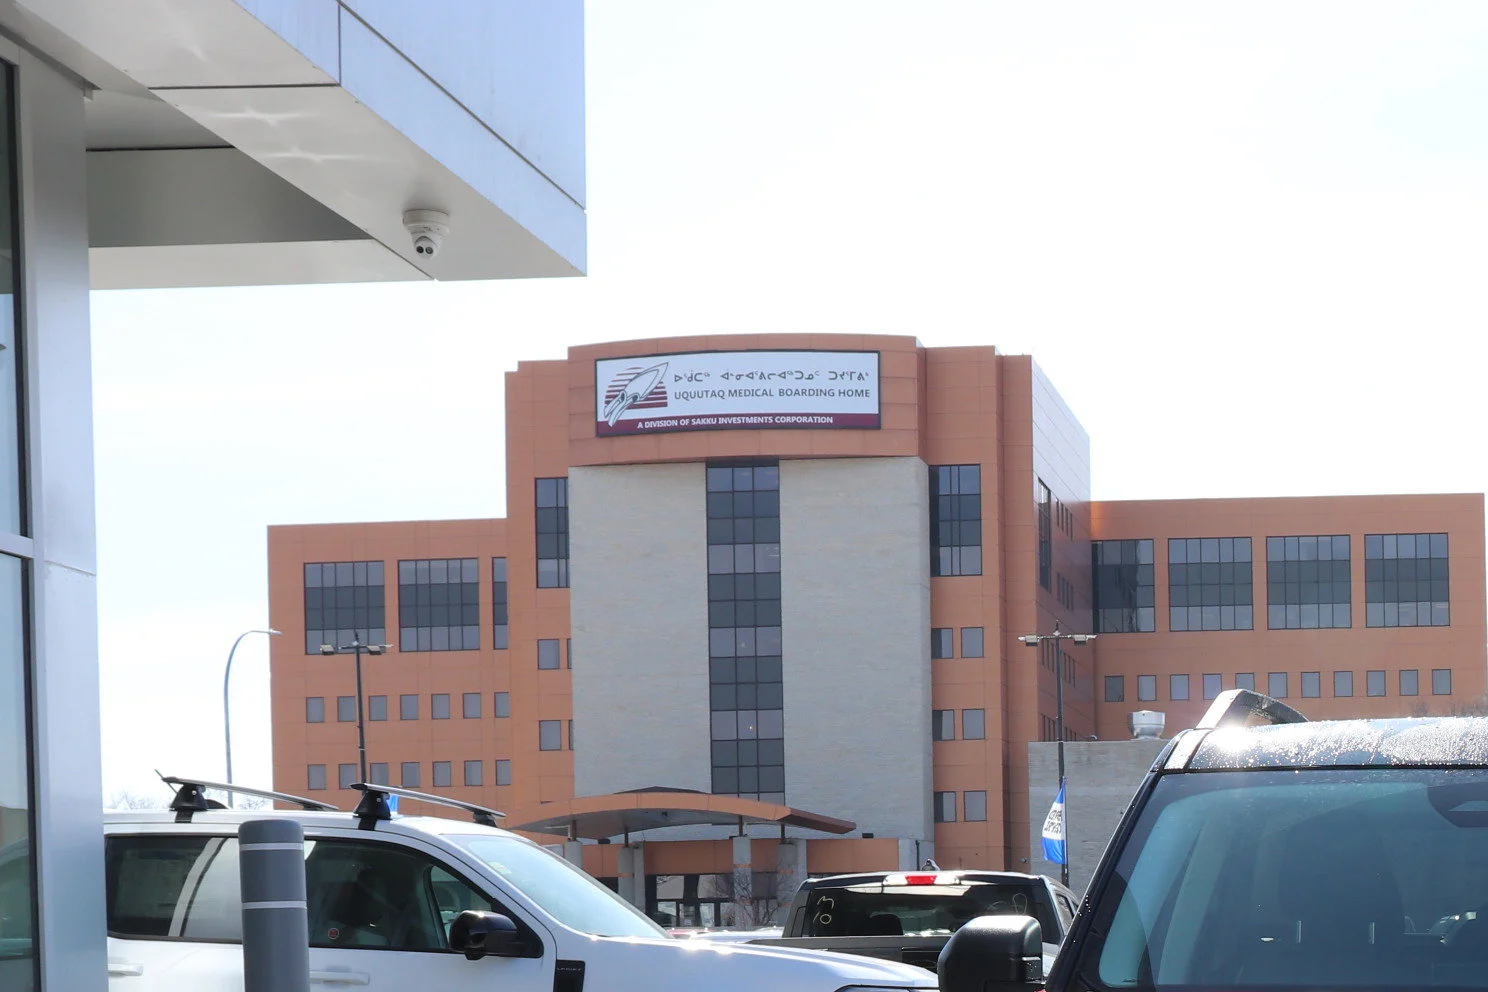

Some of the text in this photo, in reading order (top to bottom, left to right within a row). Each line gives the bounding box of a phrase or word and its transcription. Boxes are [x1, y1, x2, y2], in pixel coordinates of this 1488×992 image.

[674, 388, 870, 402] UQUUTAQ MEDICAL BOARDING HOME
[645, 420, 678, 428] DIVISION
[718, 416, 773, 424] INVESTMENTS
[774, 416, 833, 424] CORPORATION
